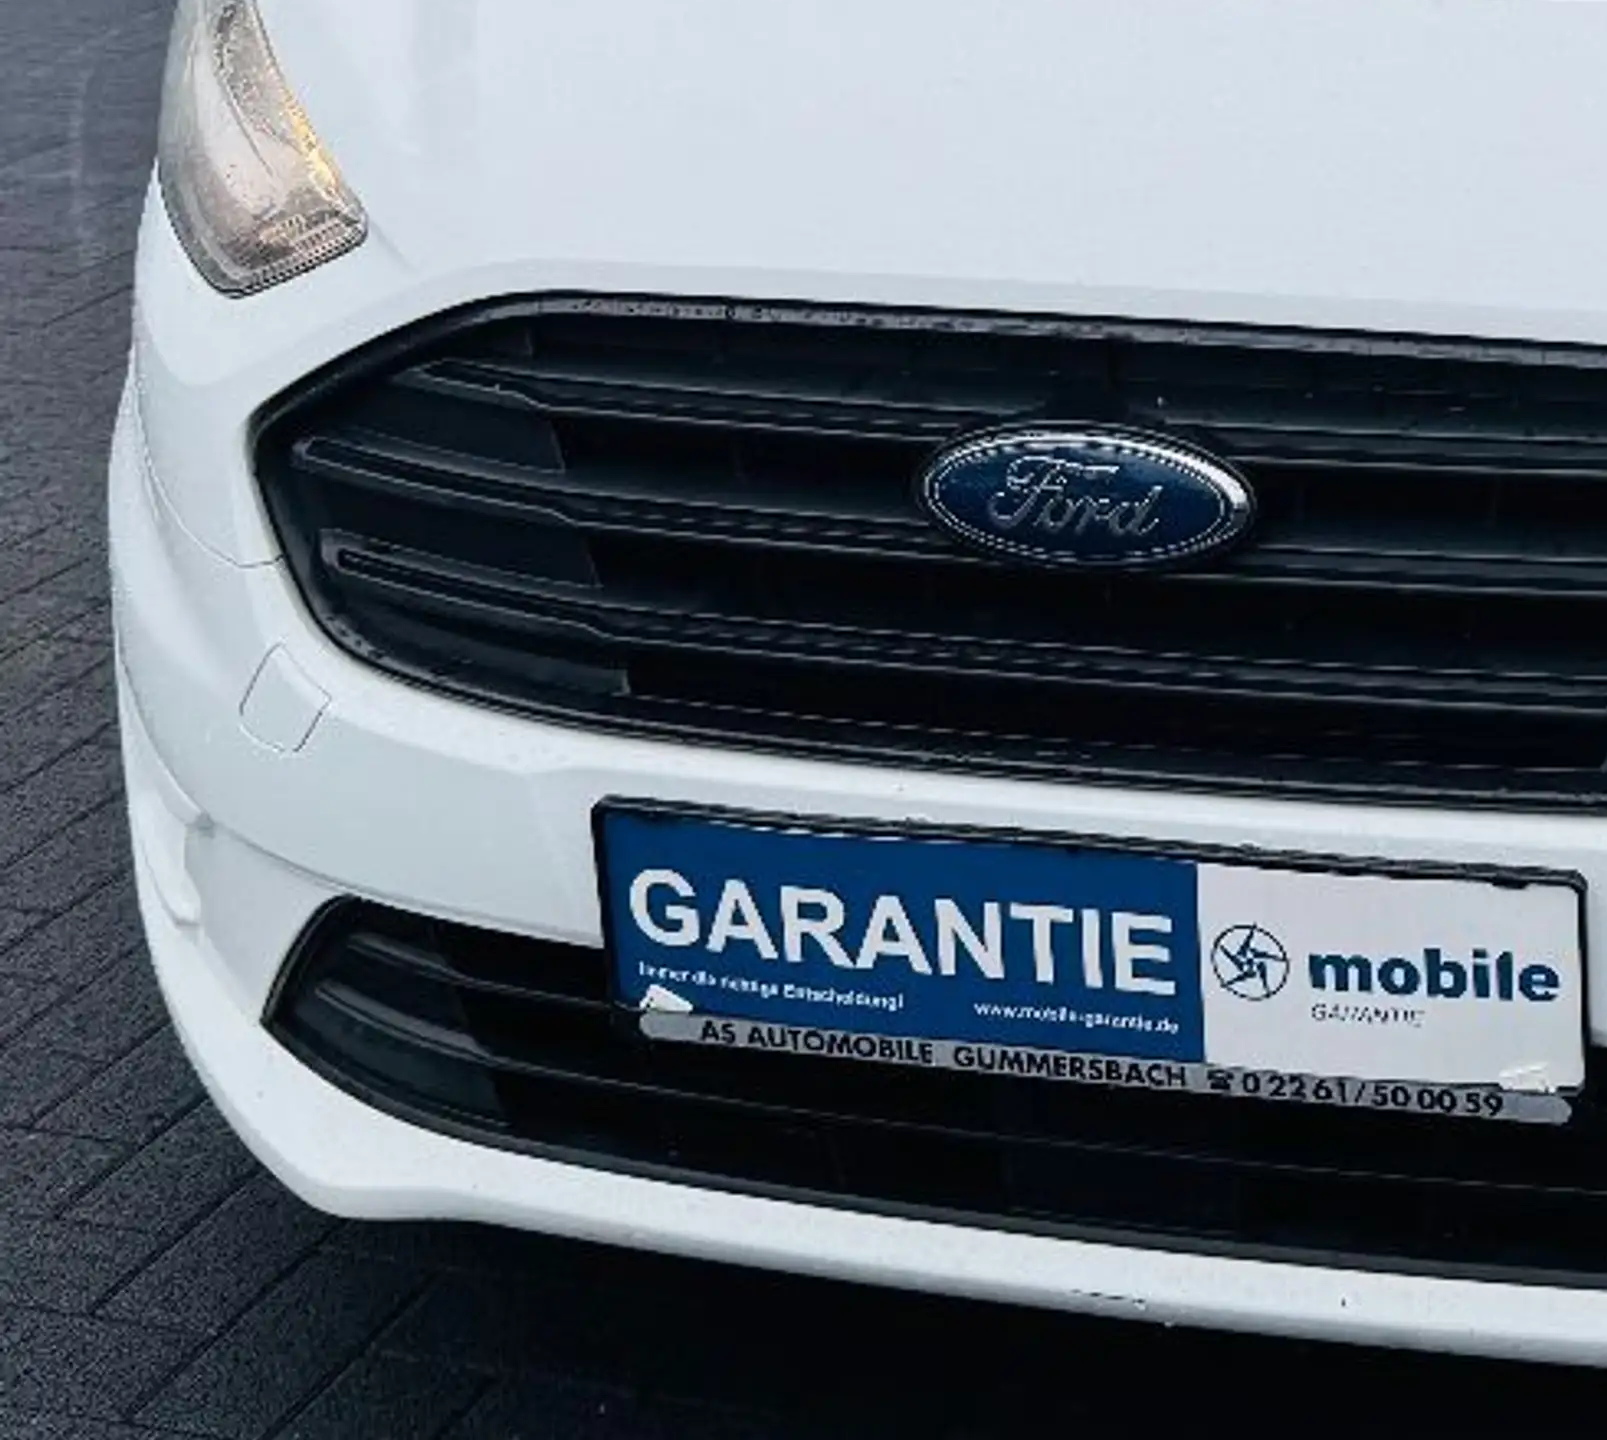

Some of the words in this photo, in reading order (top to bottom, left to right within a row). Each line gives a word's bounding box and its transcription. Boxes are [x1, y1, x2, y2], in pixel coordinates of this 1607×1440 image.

[988, 455, 1164, 536] Ford
[629, 867, 1176, 996] GARANTIE
[1308, 946, 1560, 1002] mobile
[700, 1020, 736, 1044] AS
[747, 1025, 934, 1064] AUTOMOBILE
[953, 1046, 1187, 1087] GUMMERSBACH
